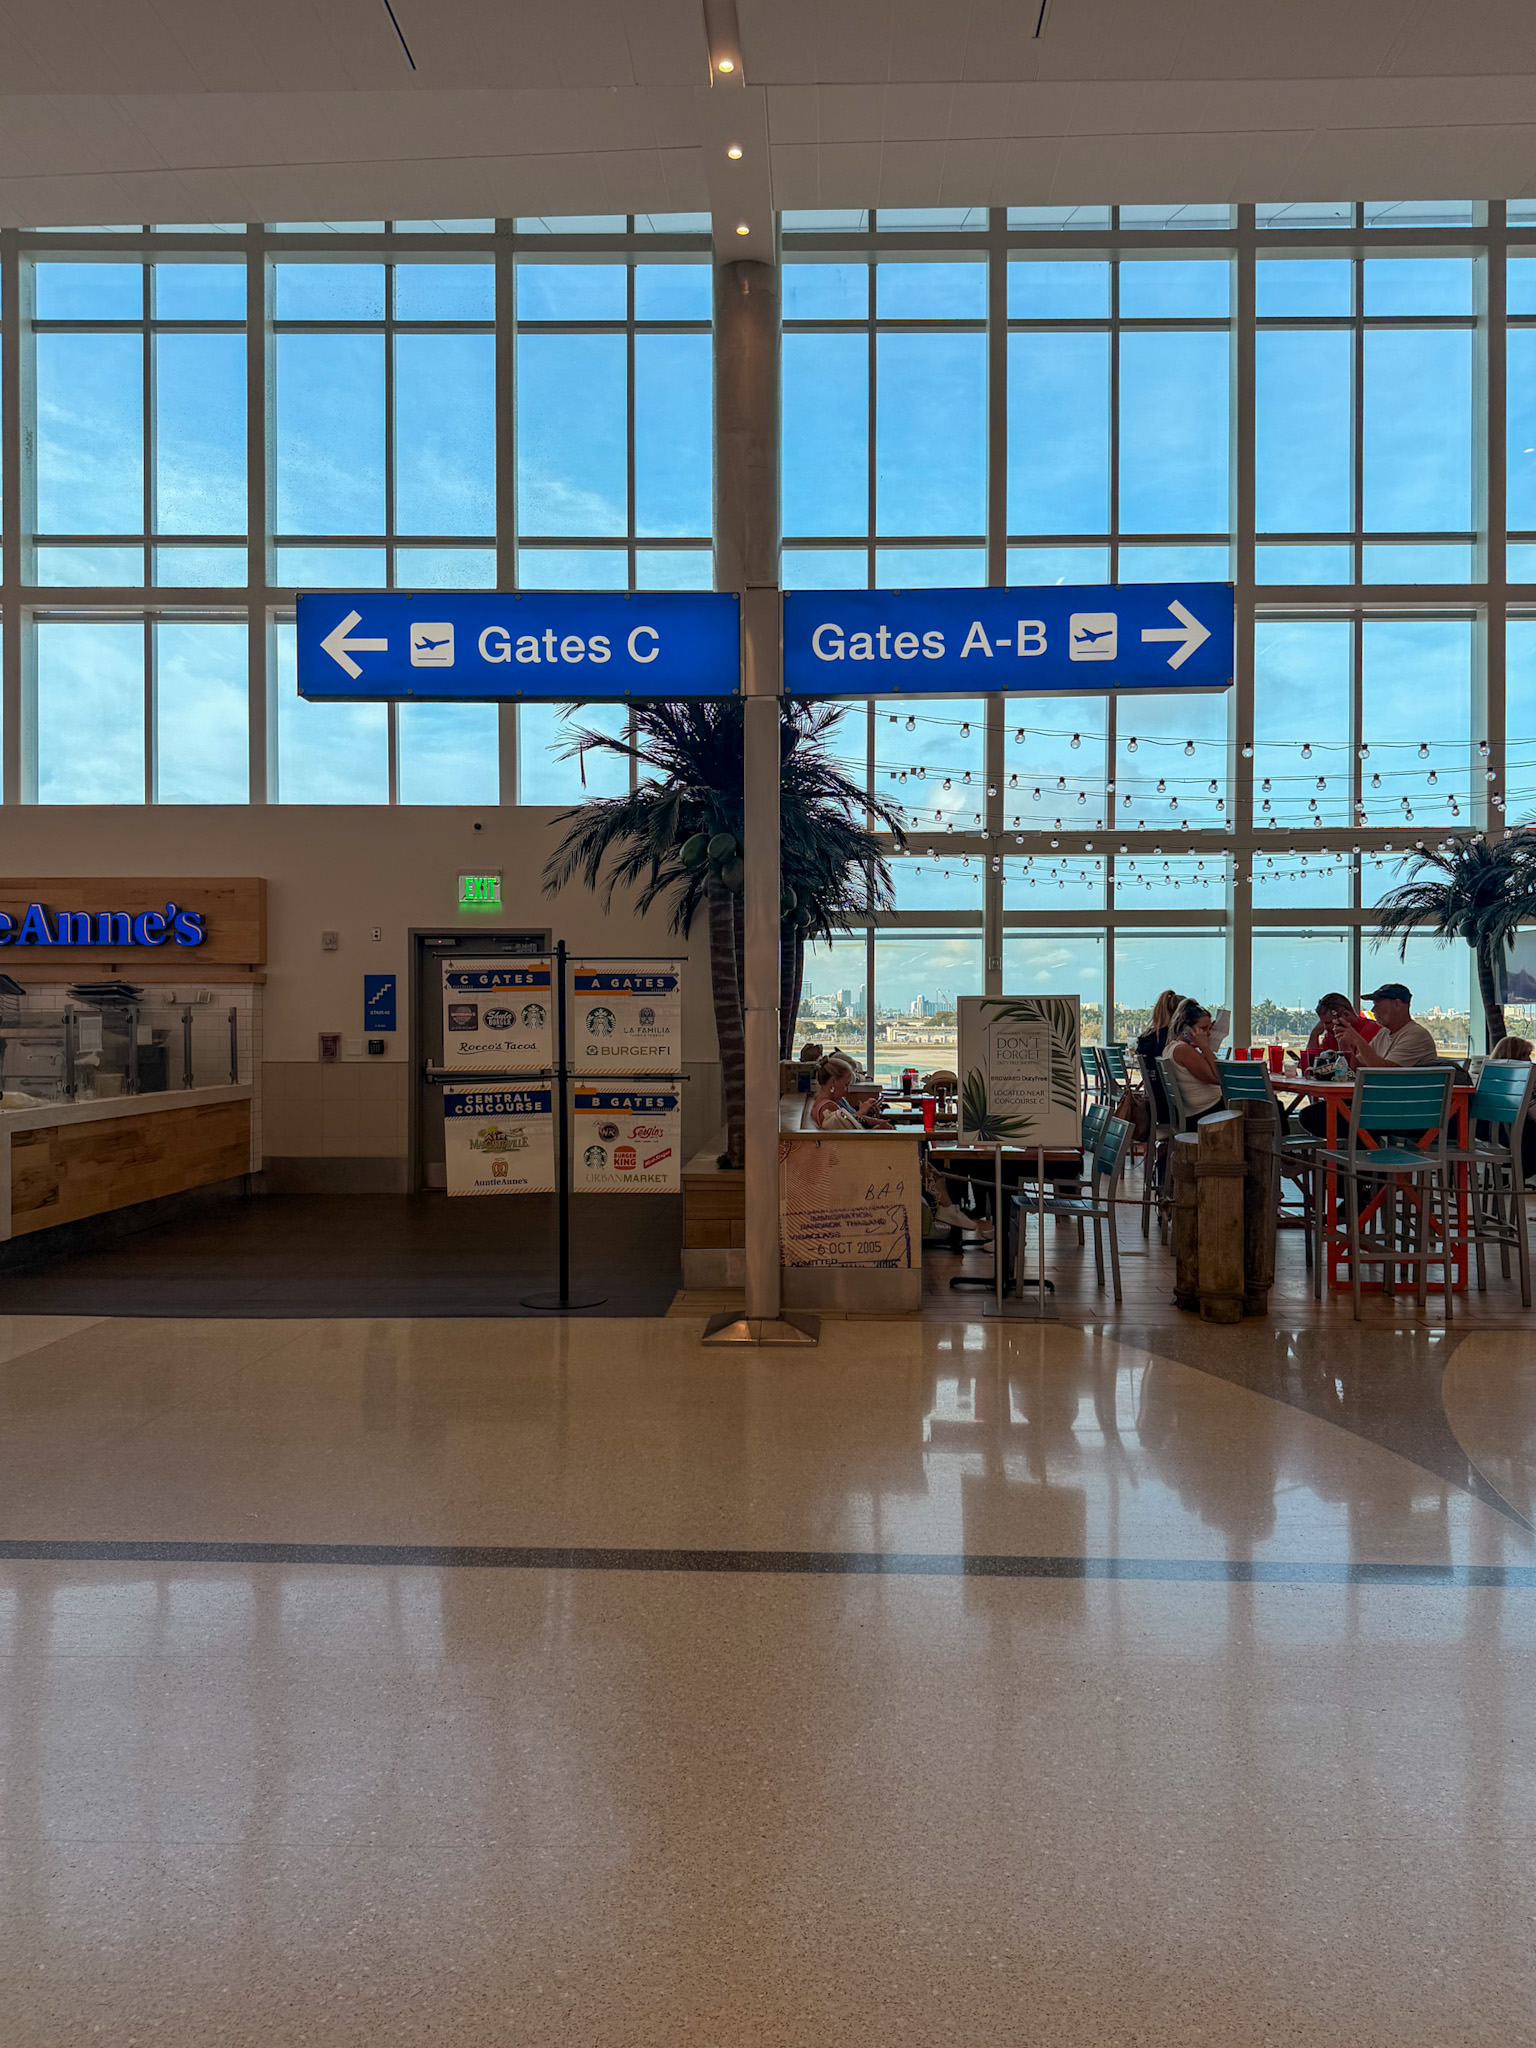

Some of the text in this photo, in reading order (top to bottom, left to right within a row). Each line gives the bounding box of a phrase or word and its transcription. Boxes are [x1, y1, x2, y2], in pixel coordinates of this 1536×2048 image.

[478, 625, 660, 665] Gates C
[811, 620, 1048, 662] Gates A-B
[465, 877, 497, 900] EXIT
[459, 974, 534, 985] C GATES
[590, 978, 665, 988] A GATES
[460, 1042, 502, 1052] Rocco's
[505, 1041, 537, 1050] Tacos
[997, 1036, 1041, 1049] DON'T
[601, 1046, 670, 1056] BURGERFI
[996, 1049, 1041, 1060] FORGET
[465, 1093, 532, 1105] CENTRAL
[591, 1097, 665, 1107] B GATES
[454, 1101, 543, 1114] CONCOURSE
[627, 1125, 664, 1139] Sergio's
[614, 1158, 636, 1166] KING
[810, 1212, 873, 1222] IMMIGRATION
[829, 1242, 853, 1254] OCT
[857, 1241, 882, 1254] 2005
[790, 1259, 838, 1267] ADMITTED
